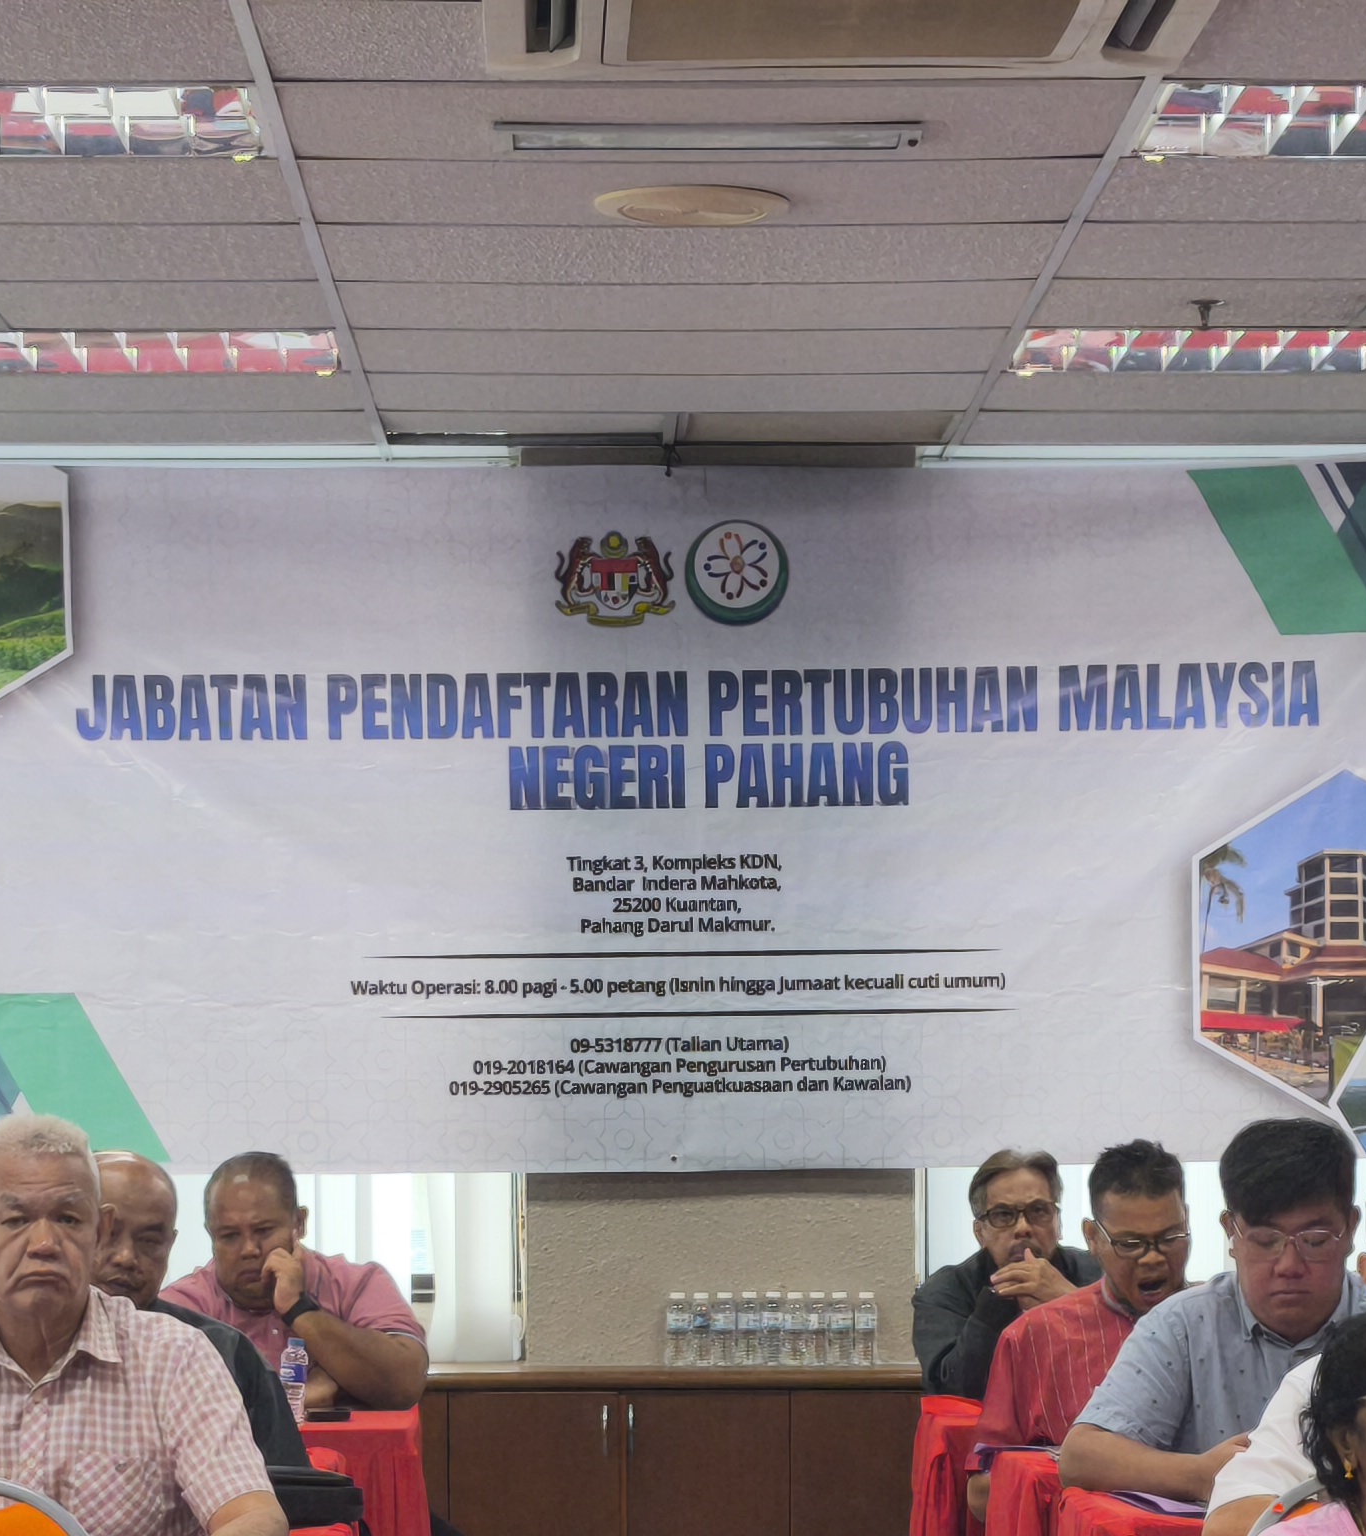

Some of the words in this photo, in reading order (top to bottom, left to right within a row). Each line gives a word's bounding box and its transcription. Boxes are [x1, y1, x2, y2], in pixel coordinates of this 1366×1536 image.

[76, 673, 308, 741] JABATAN
[327, 671, 688, 740] PENDAFTARAN
[708, 666, 1038, 736] PERTUBUHAN
[1059, 660, 1319, 732] MALAYSIA
[508, 743, 686, 810] NEGERI
[704, 740, 909, 808] PAHANG
[566, 856, 632, 875] Tingkat
[634, 855, 648, 873] 3,
[652, 854, 736, 874] Kompleks
[740, 854, 782, 872] KDN,
[573, 876, 635, 892] Bandar
[643, 875, 697, 891] Indera
[701, 874, 781, 892] Mahkota,
[612, 897, 662, 913] 25200
[666, 897, 742, 914] Kuantan,
[580, 917, 644, 937] Pahang
[648, 917, 694, 933] Darul
[699, 916, 776, 933] Makmur.
[351, 980, 408, 995] Waktu
[411, 979, 481, 999] Operasi:
[484, 979, 518, 995] 8.00
[522, 978, 557, 998] pagi
[570, 978, 603, 994] 5.00
[607, 977, 666, 997] petang
[669, 977, 715, 996] (Isnin
[719, 976, 775, 996] hingga
[779, 975, 839, 994] Jumaat
[844, 974, 904, 990] kecuali
[908, 973, 939, 989] cuti
[944, 972, 1006, 990] umum)
[570, 1037, 663, 1053] 09-5318777
[665, 1036, 722, 1055] (Talian
[726, 1036, 790, 1053] Utama)
[473, 1059, 575, 1075] 019-2018164
[578, 1058, 672, 1078] (Cawangan
[676, 1057, 776, 1076] Pengurusan
[780, 1055, 886, 1073] Pertubuhan)
[449, 1080, 551, 1096] 019-2905265
[554, 1079, 648, 1098] (Cawangan
[652, 1077, 793, 1098] Penguatkuasaan
[797, 1076, 829, 1092] dan
[833, 1075, 912, 1093] Kawalan)
